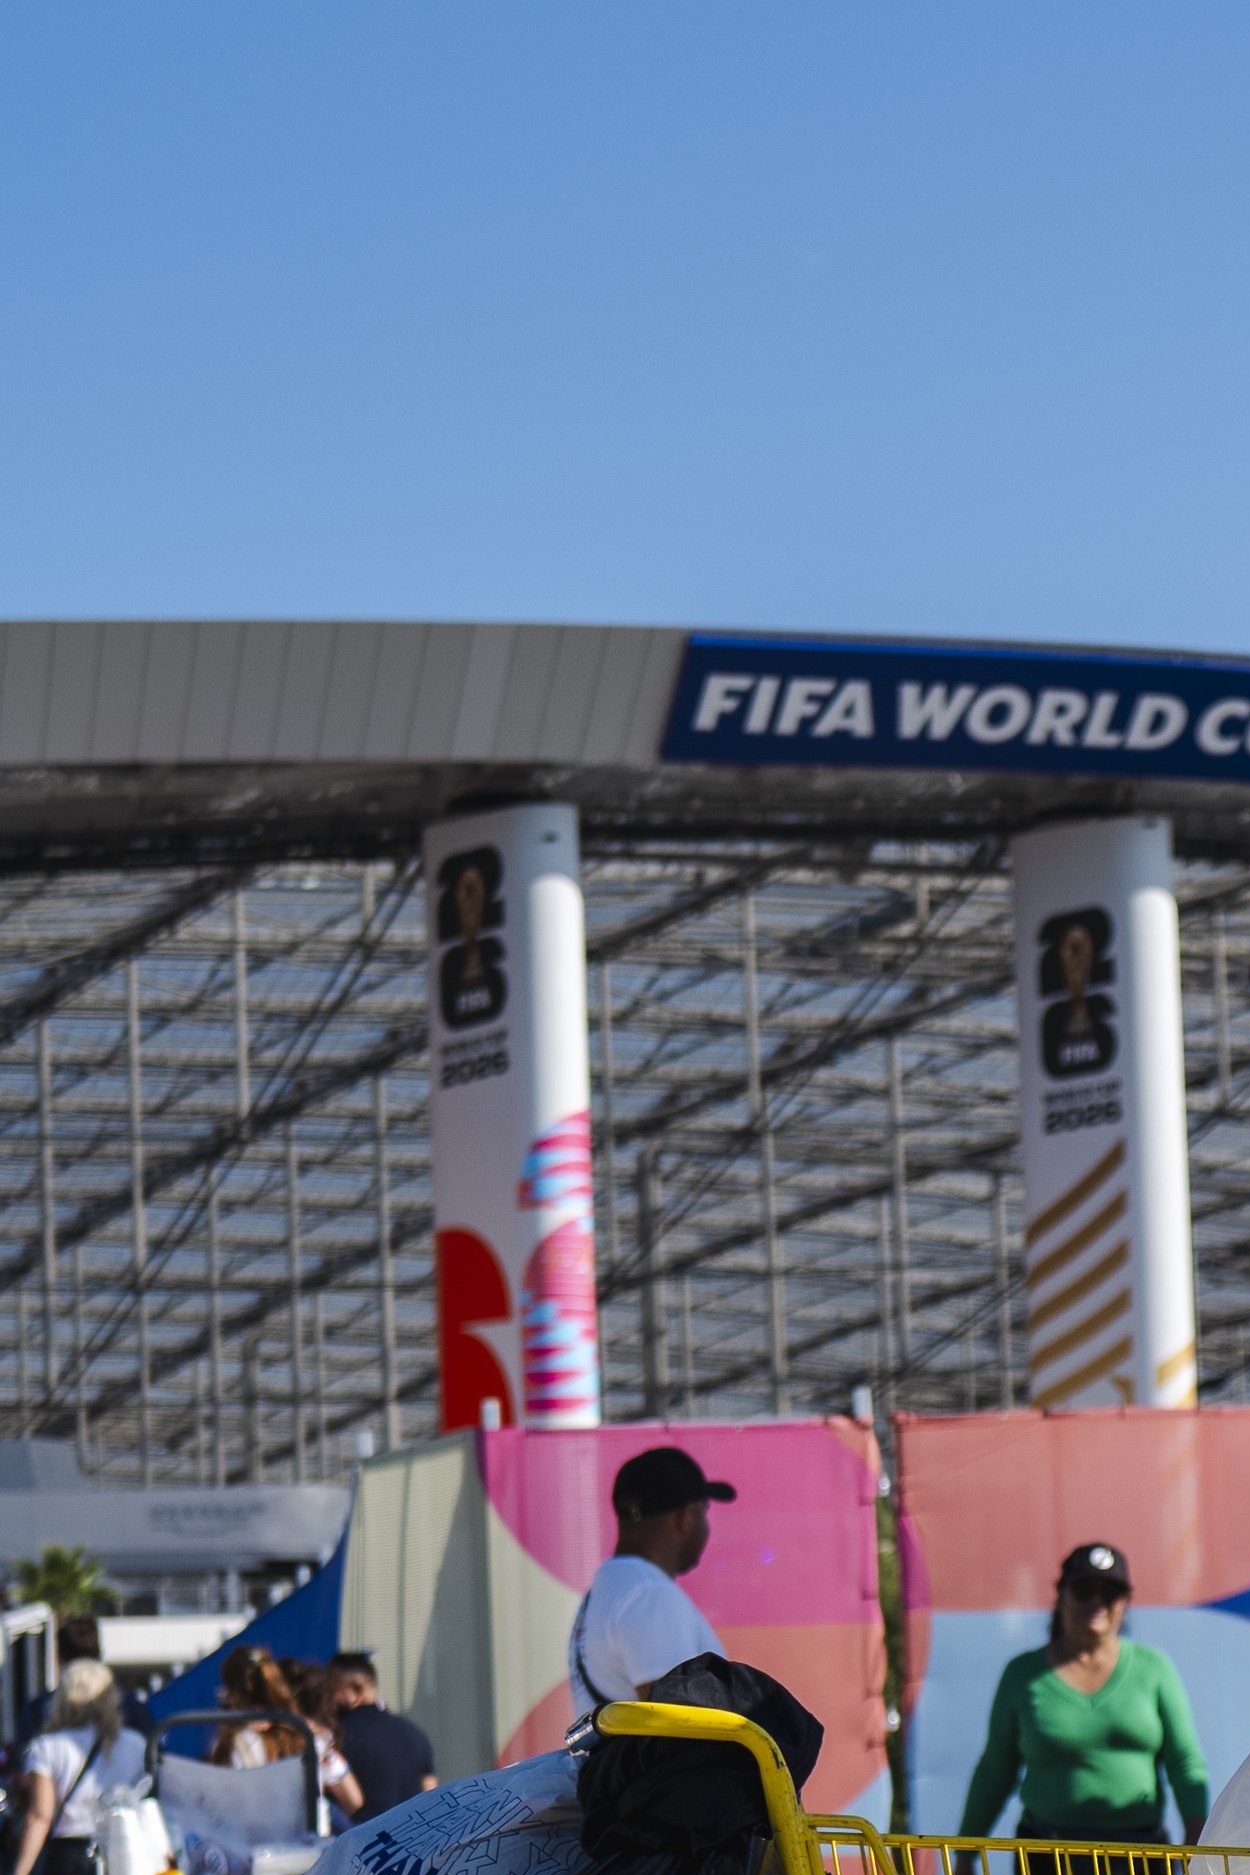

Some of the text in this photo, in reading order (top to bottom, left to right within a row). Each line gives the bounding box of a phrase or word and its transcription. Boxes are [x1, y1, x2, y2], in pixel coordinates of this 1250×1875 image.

[692, 671, 876, 739] FIFA
[894, 682, 1189, 750] WORLD
[441, 1049, 509, 1089] 2026
[1045, 1099, 1122, 1134] 2026
